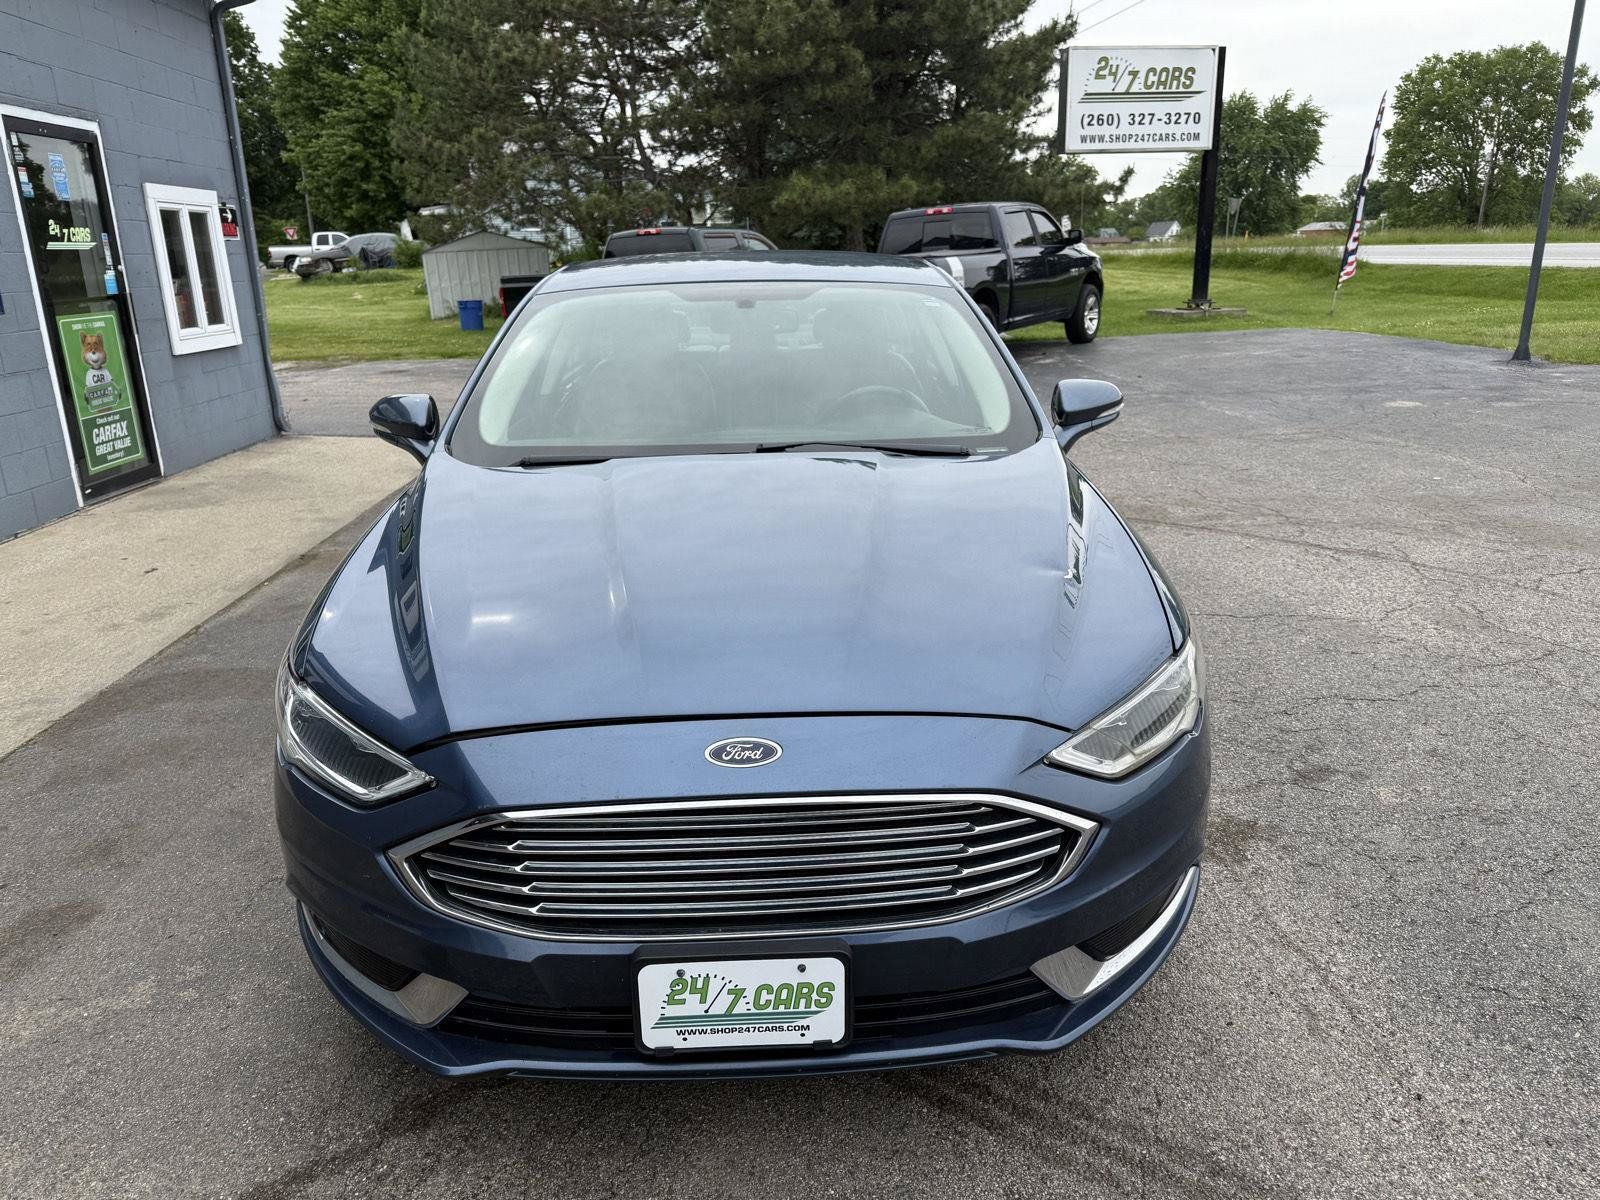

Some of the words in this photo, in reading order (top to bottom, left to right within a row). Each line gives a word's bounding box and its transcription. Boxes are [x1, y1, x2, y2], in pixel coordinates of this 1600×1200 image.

[1143, 66, 1197, 91] CARS
[1080, 112, 1121, 129] (260)
[1128, 112, 1201, 126] 327-3270
[1080, 132, 1201, 144] WWW.SHOP247CARS.COM
[69, 227, 91, 242] CARS
[92, 373, 106, 384] CAR
[92, 420, 128, 445] CARFAX
[95, 441, 113, 456] GREAT
[113, 436, 132, 450] VALUE
[722, 744, 764, 760] Ford
[752, 981, 836, 1011] CARS
[675, 1024, 811, 1036] WWW.SHOP247CARS.COM
